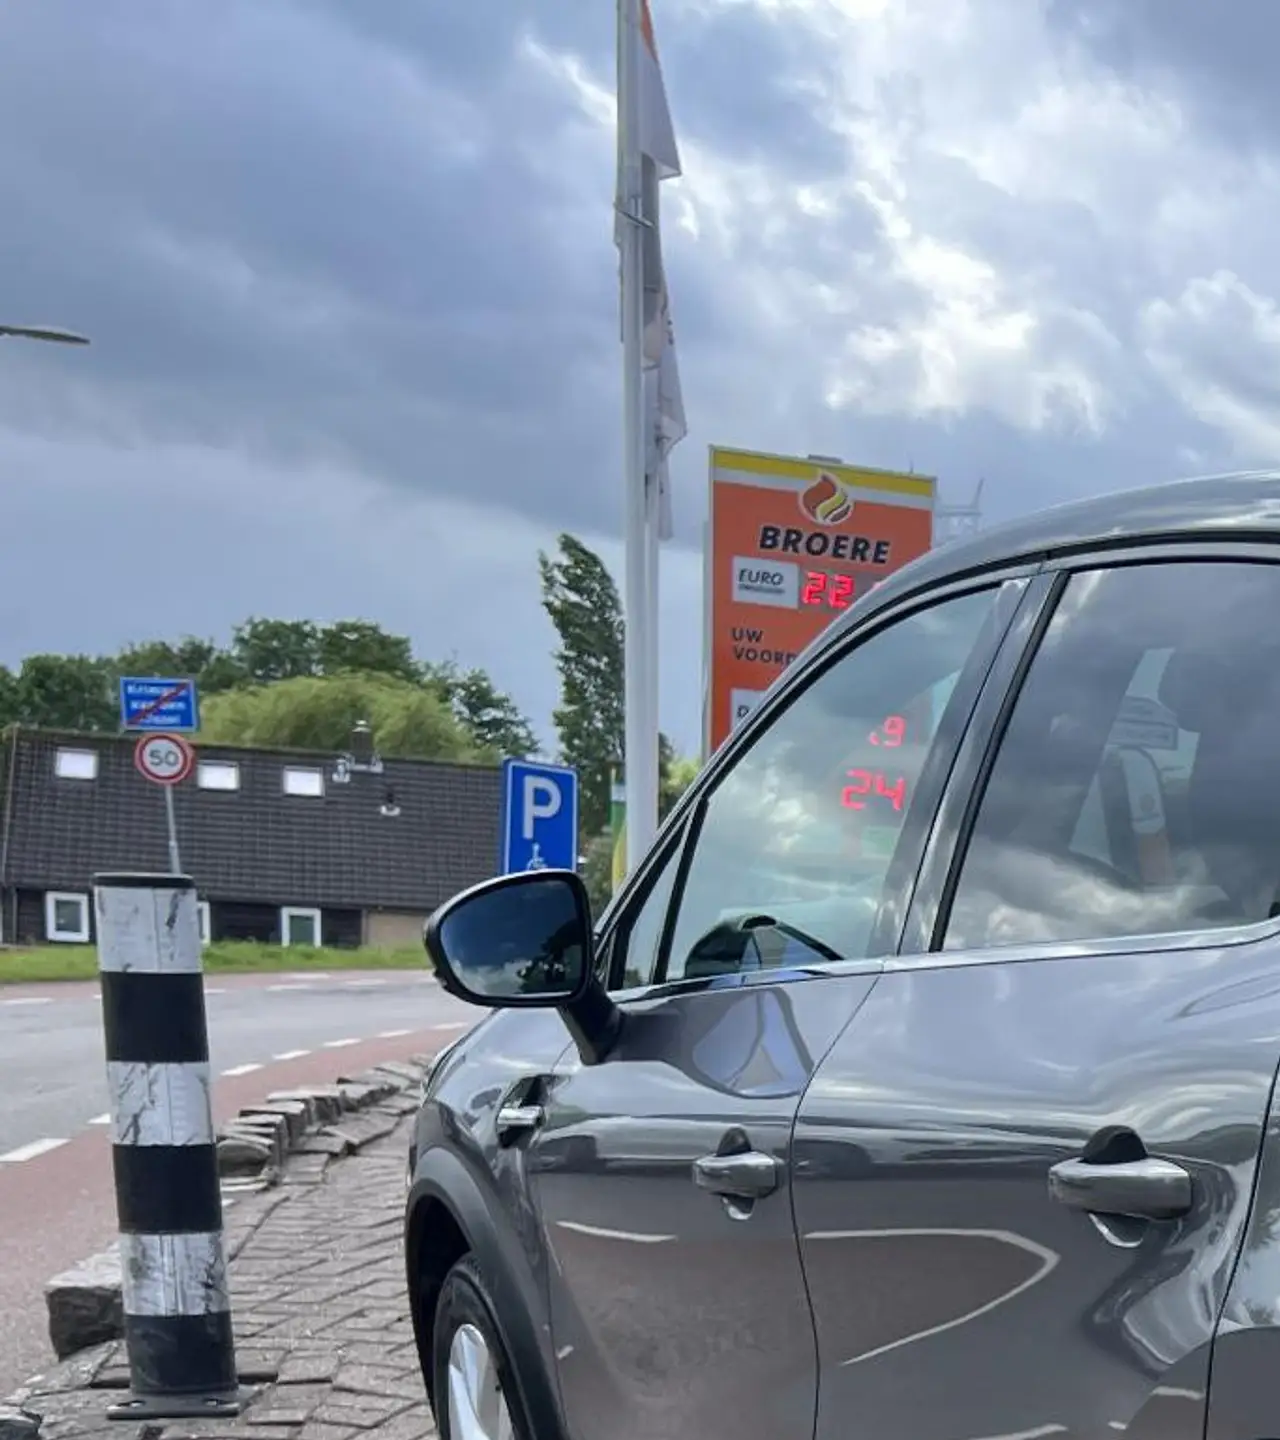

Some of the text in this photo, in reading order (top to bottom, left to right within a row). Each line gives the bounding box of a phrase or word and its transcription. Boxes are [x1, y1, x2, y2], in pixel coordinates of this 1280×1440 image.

[759, 526, 891, 564] BROERE
[738, 568, 784, 585] EURO
[732, 627, 762, 643] UW
[148, 748, 179, 767] 50
[523, 775, 562, 840] P
